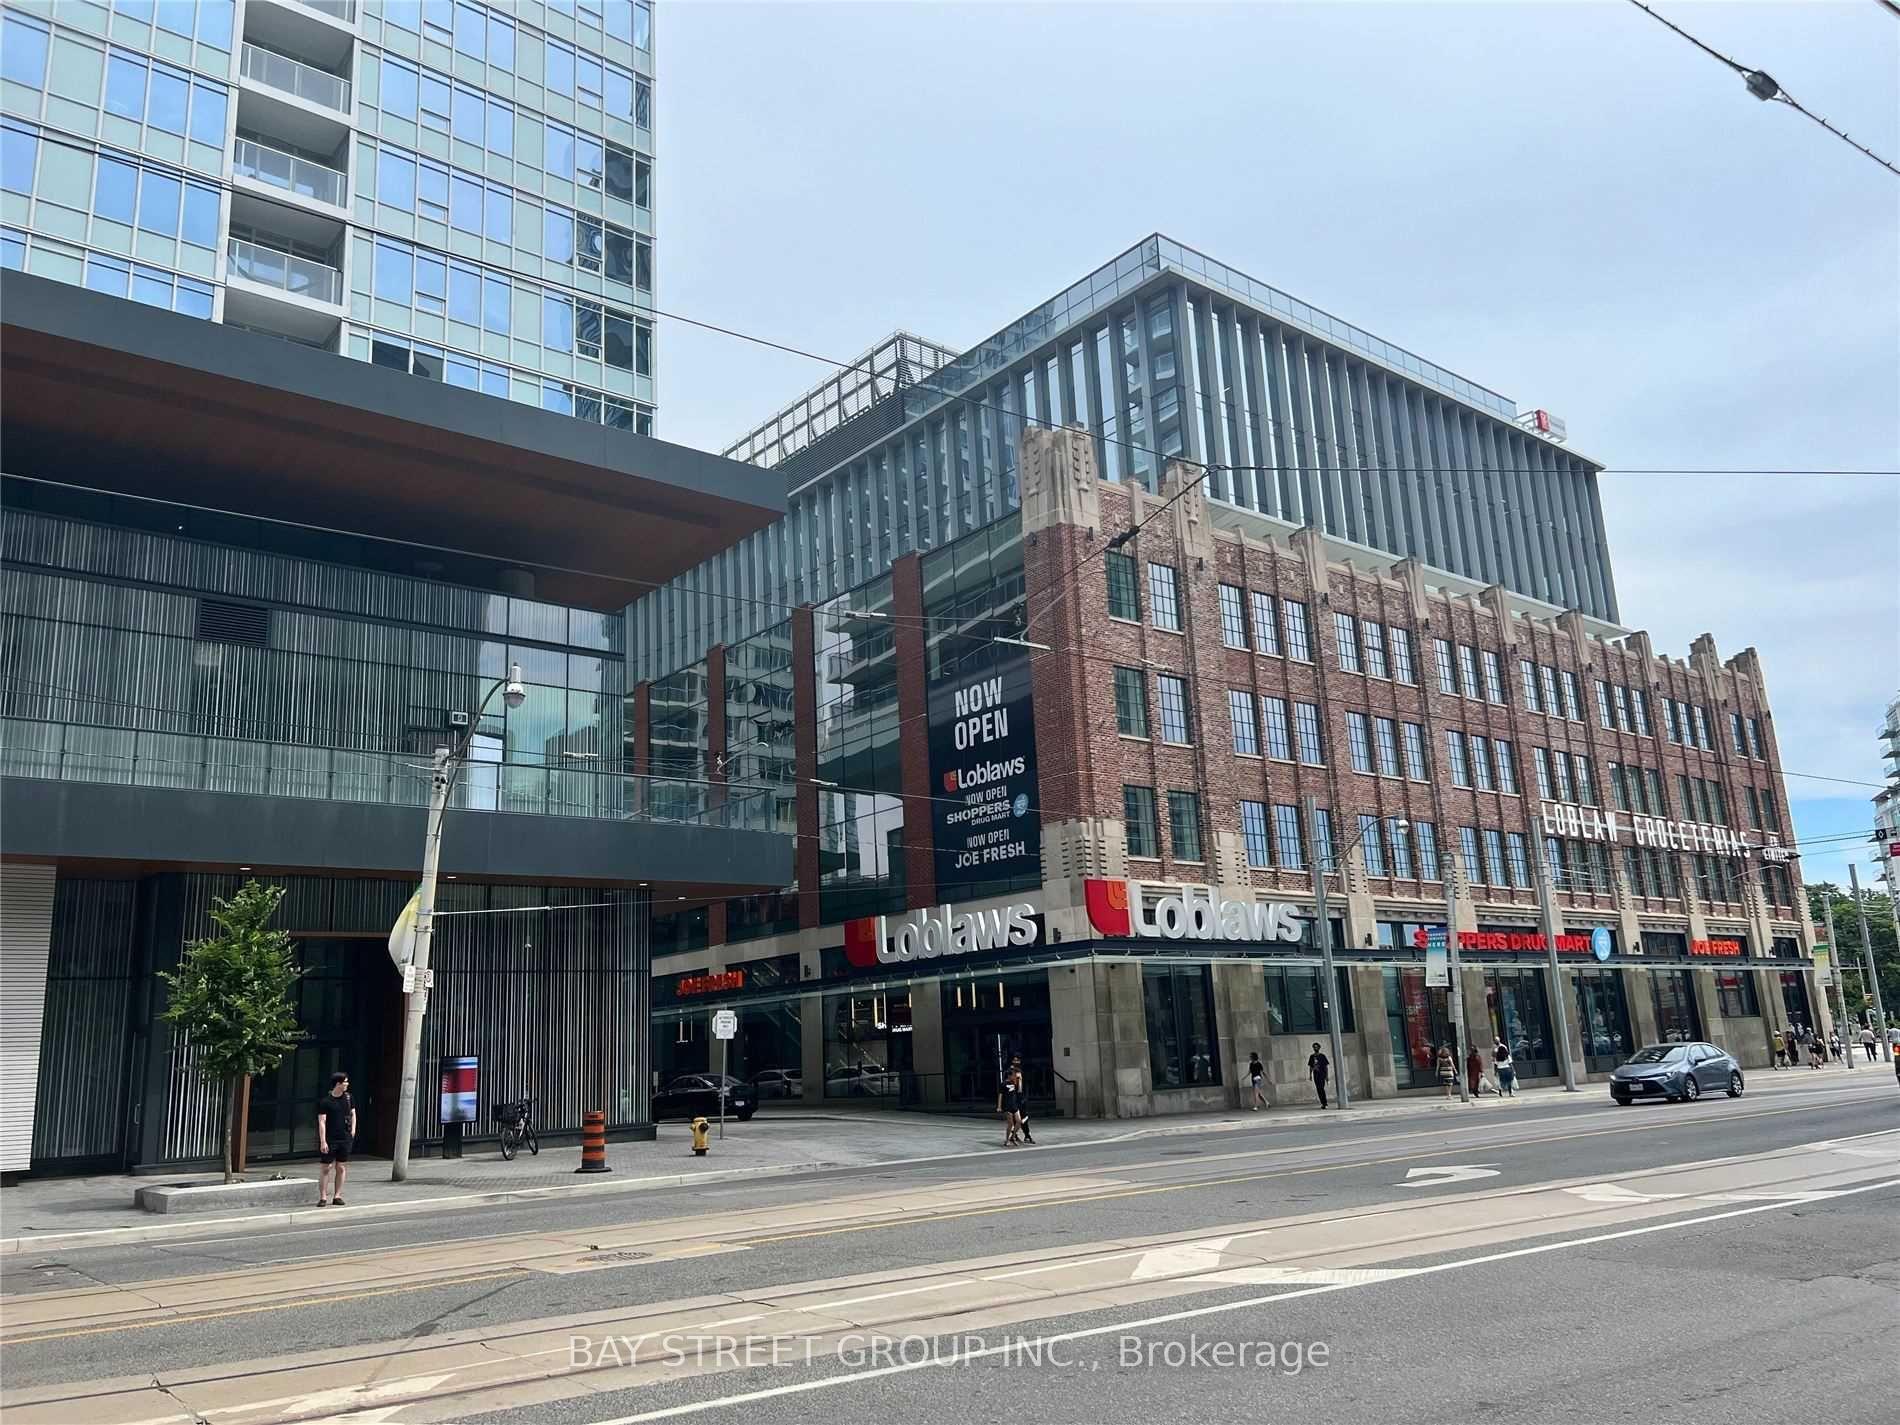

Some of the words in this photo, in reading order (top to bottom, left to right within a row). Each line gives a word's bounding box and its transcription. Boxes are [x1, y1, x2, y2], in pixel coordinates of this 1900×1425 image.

[954, 676, 1002, 717] NOW
[954, 708, 1008, 750] OPEN
[958, 757, 1025, 789] Loblaws
[966, 791, 984, 806] NOW
[986, 785, 1007, 801] OPEN
[946, 800, 1011, 825] SHOPPERS
[971, 815, 990, 826] DRUG
[991, 811, 1011, 822] MART
[967, 834, 986, 849] NOW
[988, 829, 1010, 844] OPEN
[1541, 802, 1618, 842] LOBLAW
[1632, 815, 1751, 858] GROCETERIAS
[955, 850, 980, 868] JOE
[983, 841, 1025, 864] FRESH
[1127, 881, 1301, 942] Loblaws
[875, 903, 1038, 964] Loblaws
[1554, 935, 1591, 952] MART
[1711, 940, 1741, 956] FRESH
